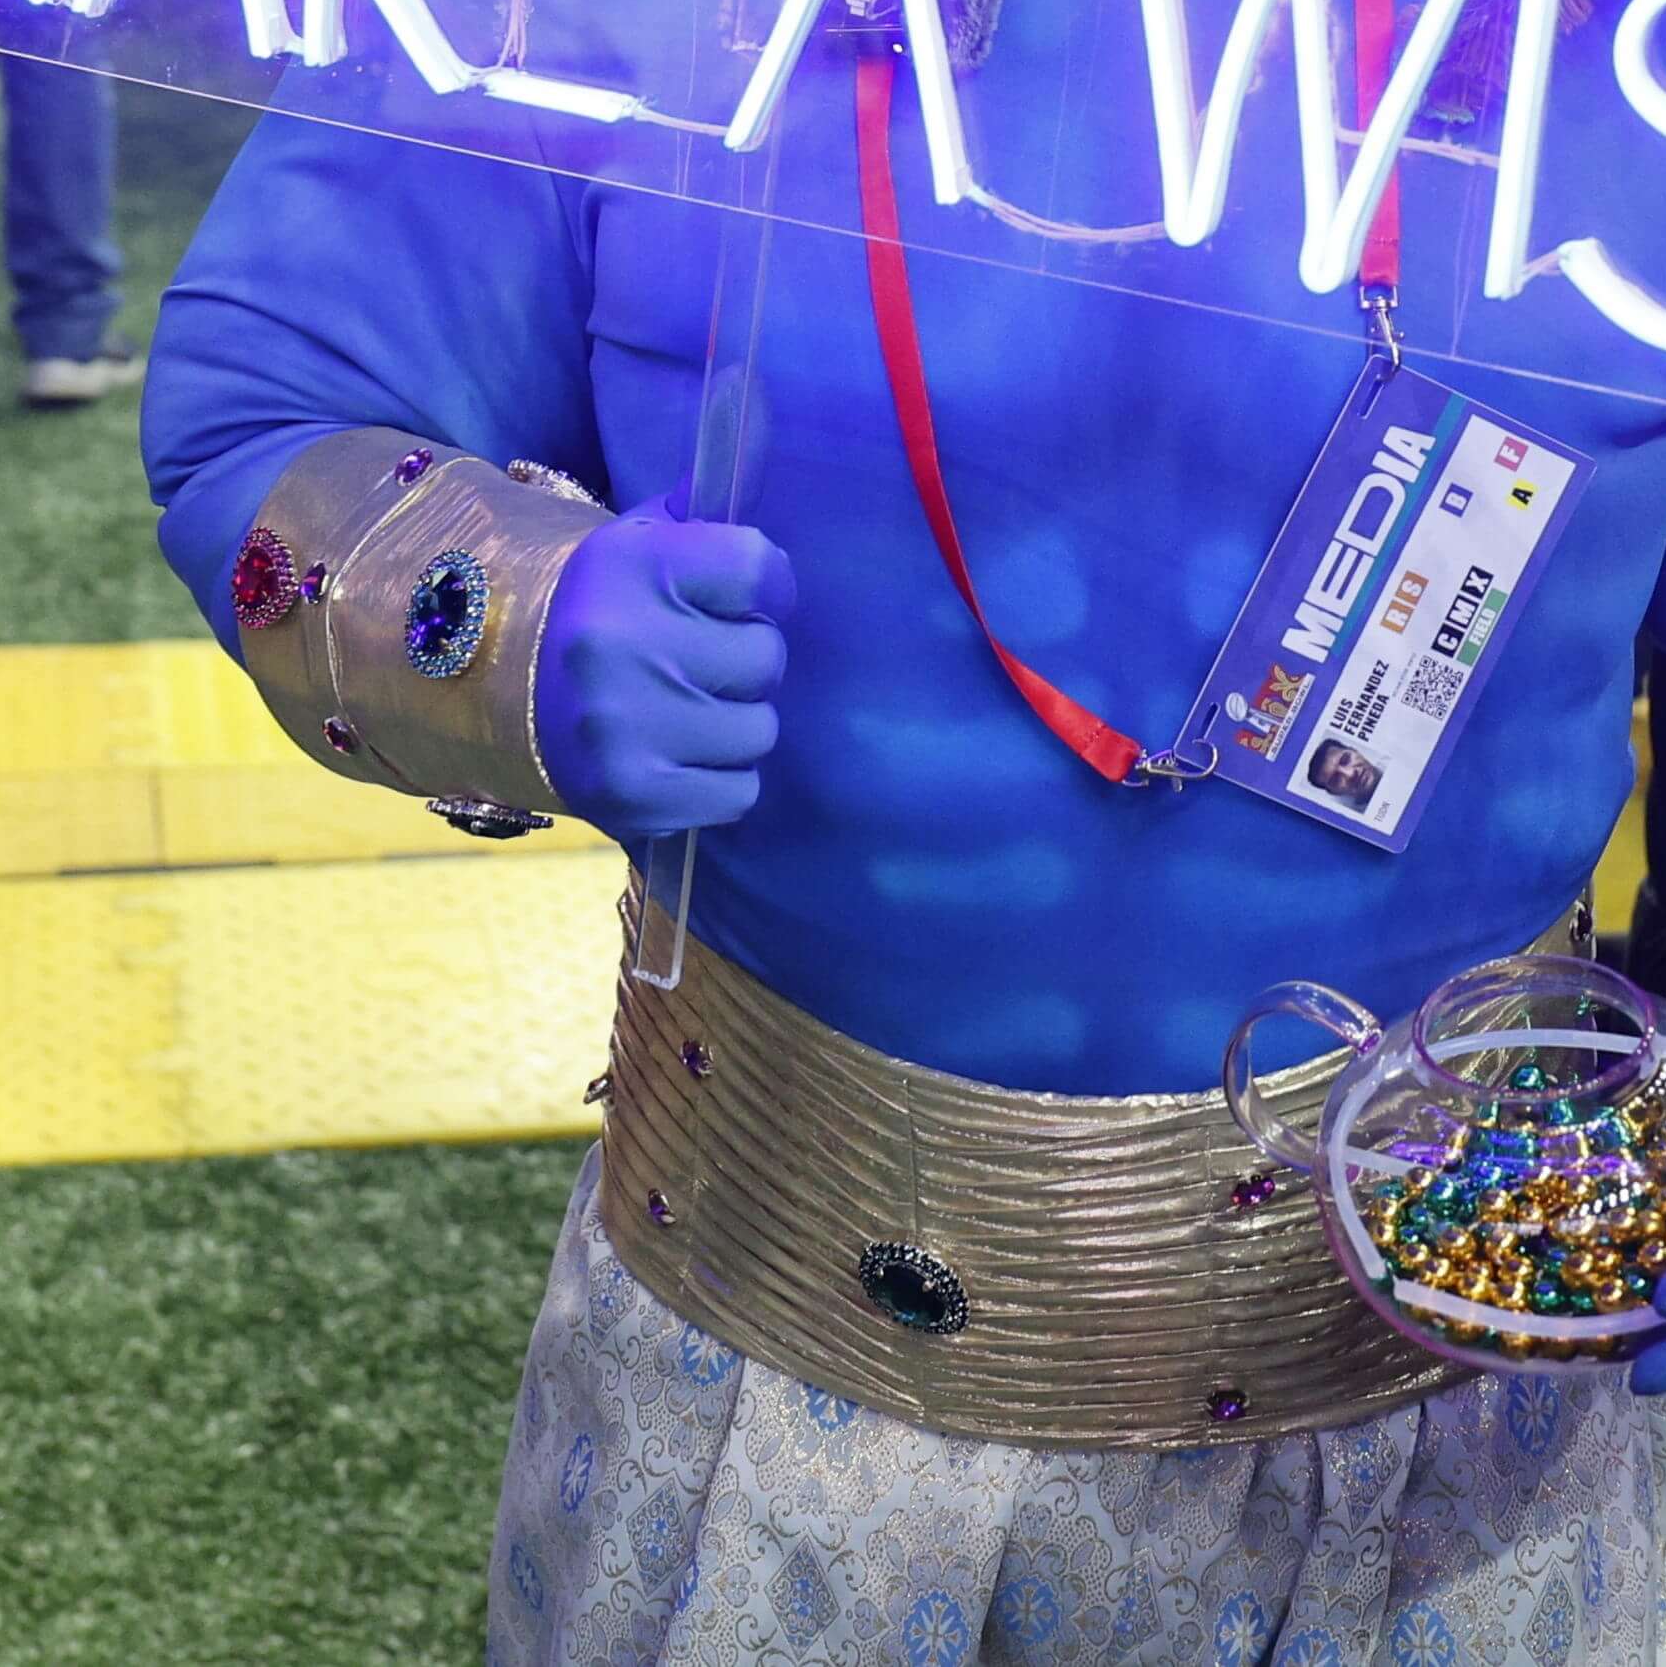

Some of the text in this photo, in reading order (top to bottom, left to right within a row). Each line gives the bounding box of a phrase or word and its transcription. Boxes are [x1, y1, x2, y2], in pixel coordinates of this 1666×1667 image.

[1511, 486, 1534, 507] A
[1282, 425, 1437, 664] MEDIA
[1468, 607, 1497, 647] FIELD
[1329, 698, 1354, 730] LUIS
[1343, 658, 1390, 736] FERNANDEZ
[1358, 693, 1390, 742] PINEDA
